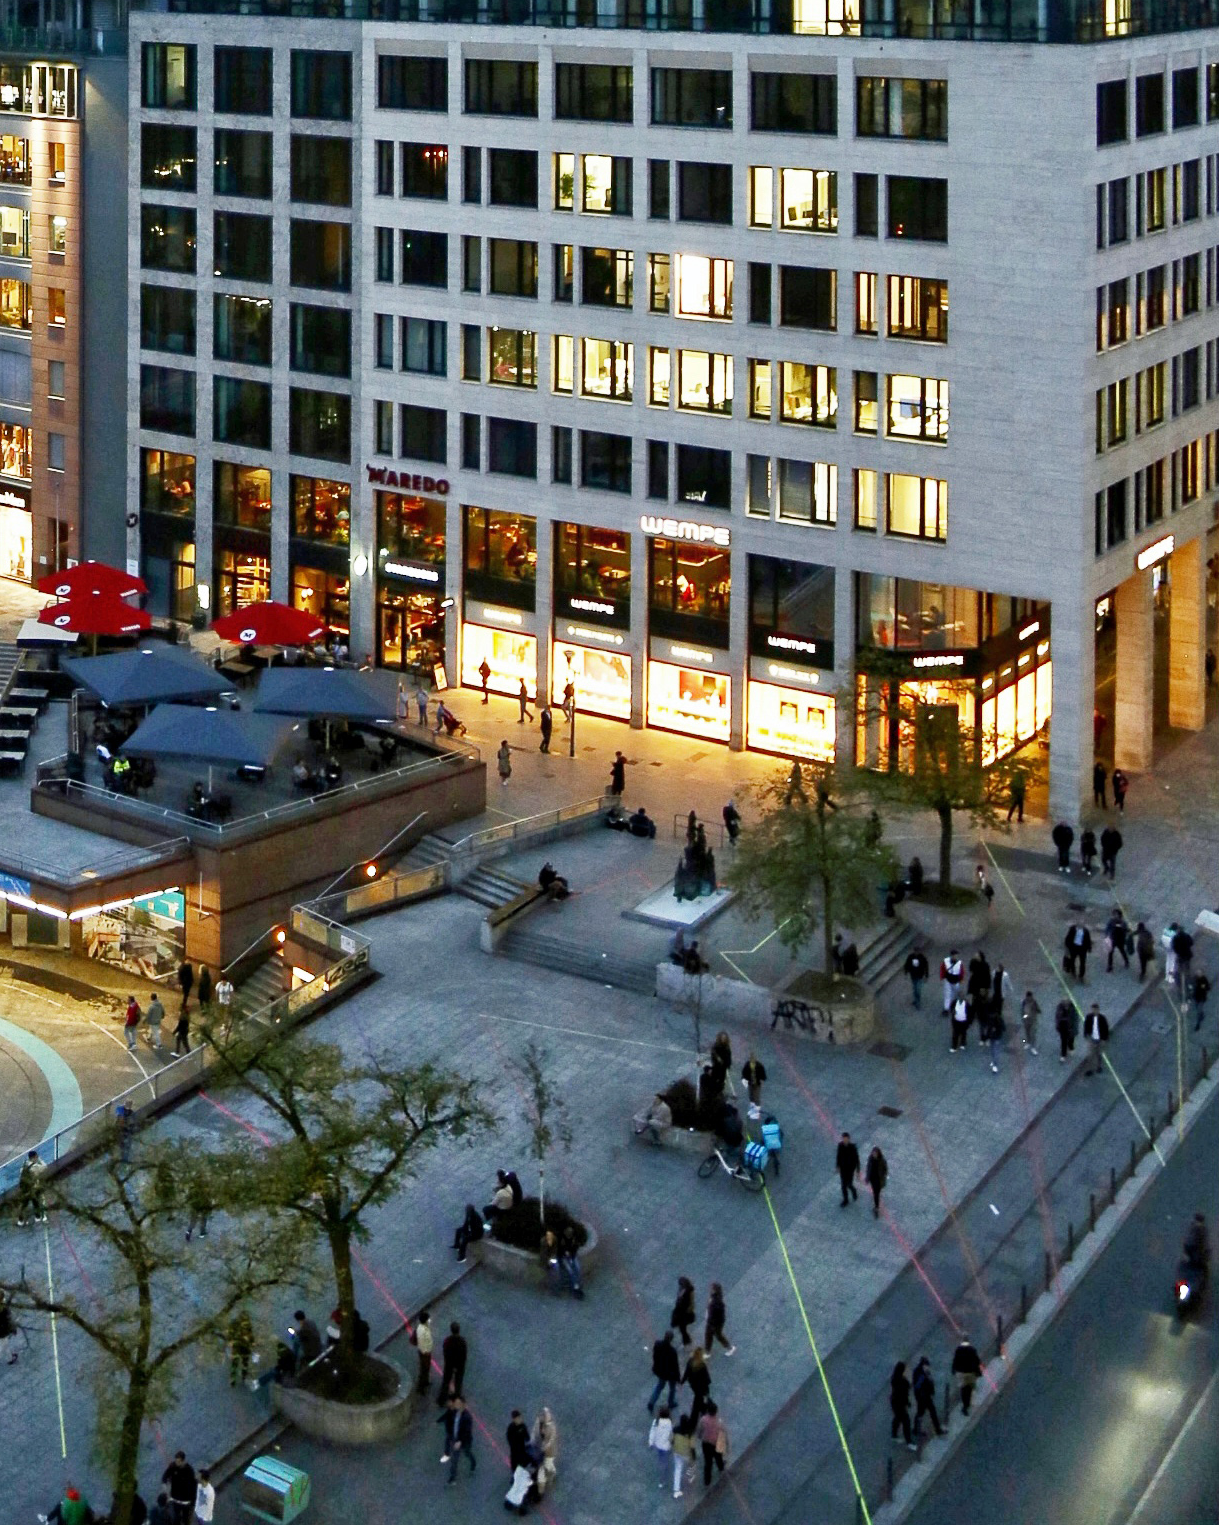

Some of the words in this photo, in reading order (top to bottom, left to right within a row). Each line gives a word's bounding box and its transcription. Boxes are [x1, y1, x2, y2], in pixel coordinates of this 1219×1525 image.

[366, 463, 450, 495] MAREDO
[640, 515, 730, 546] WEMPE
[570, 598, 615, 615] WEMPE
[767, 635, 816, 654] WEMPE
[913, 655, 964, 668] WEMPE
